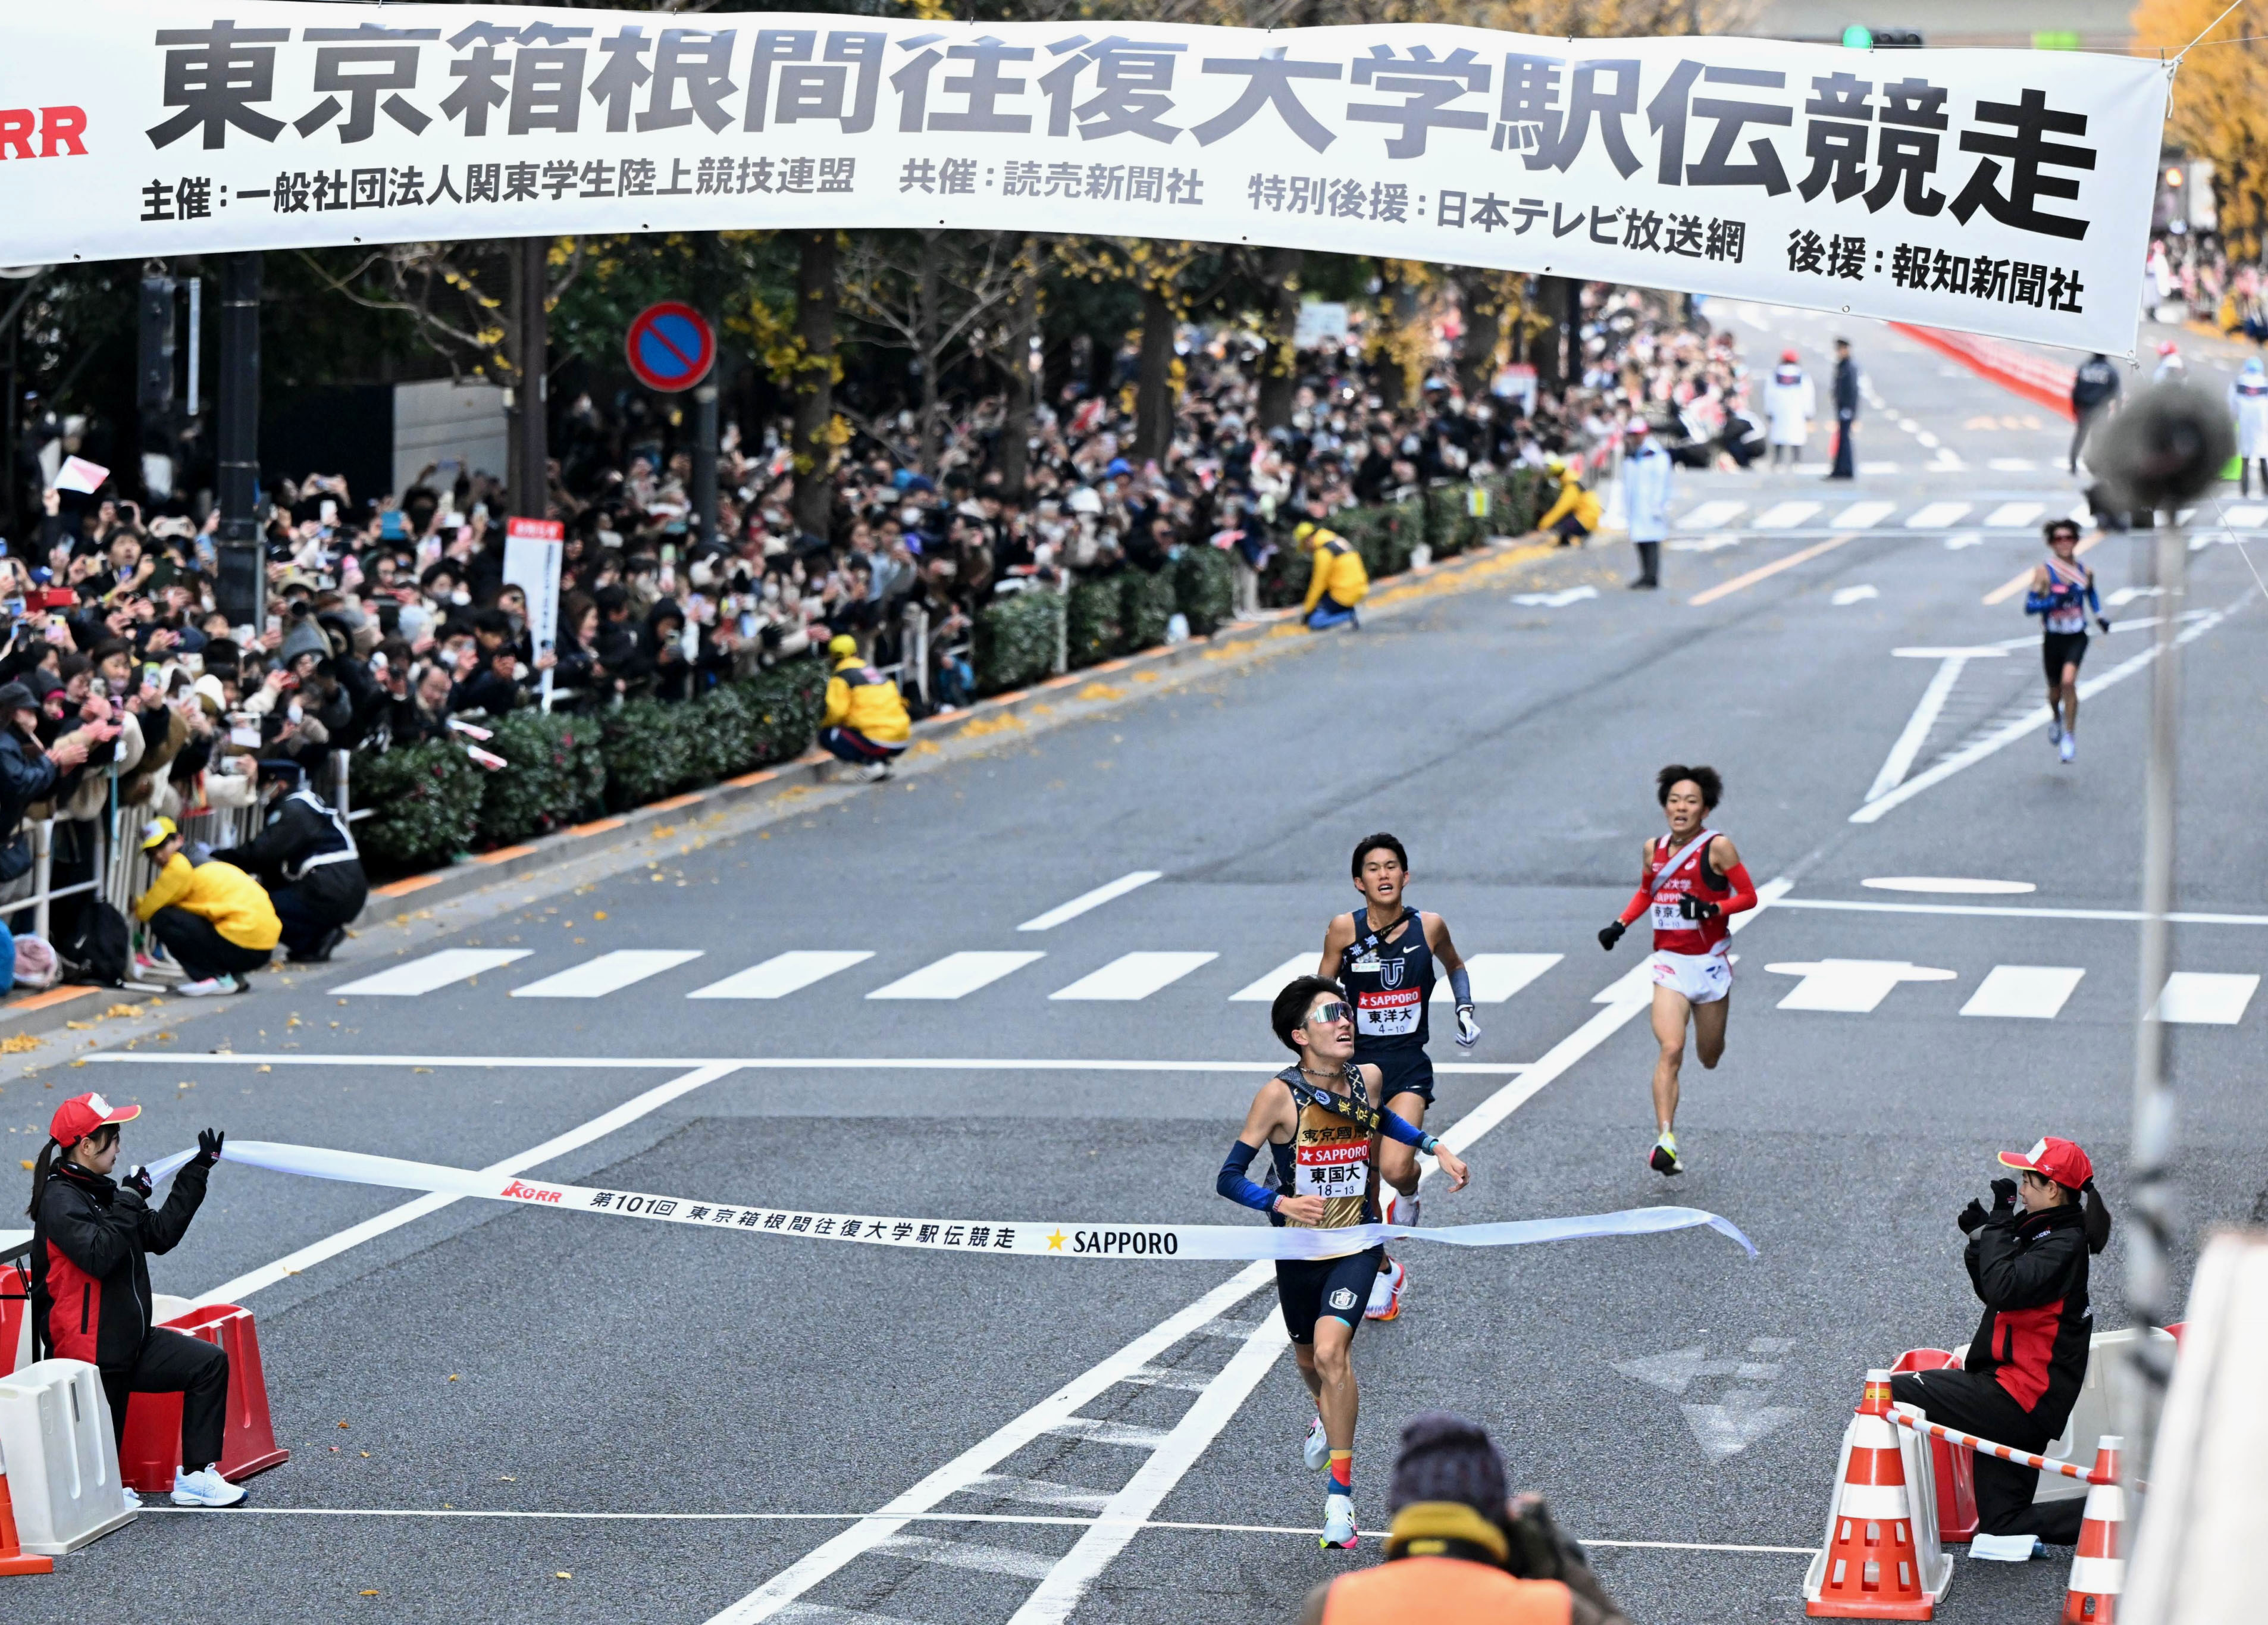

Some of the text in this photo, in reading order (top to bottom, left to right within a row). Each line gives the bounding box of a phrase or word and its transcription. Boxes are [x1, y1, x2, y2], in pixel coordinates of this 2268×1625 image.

[145, 19, 2097, 240] 東京箱根間往復大学駅伝競走
[141, 156, 2084, 314] 主催：一般社団法人関東学生陸上競技連盟 共催：読売新聞社 特別後援：日本テレビ放送網 後援：報知新聞社
[1370, 991, 1418, 1006] SAPPORO
[1367, 1008, 1412, 1023] 東洋大
[1315, 1145, 1367, 1161] SAPPORO
[1310, 1164, 1360, 1183] 東国大
[500, 1181, 1178, 1254] KGRR 第101回 東京箱根間往復大学駅伝競走 SAPPORO
